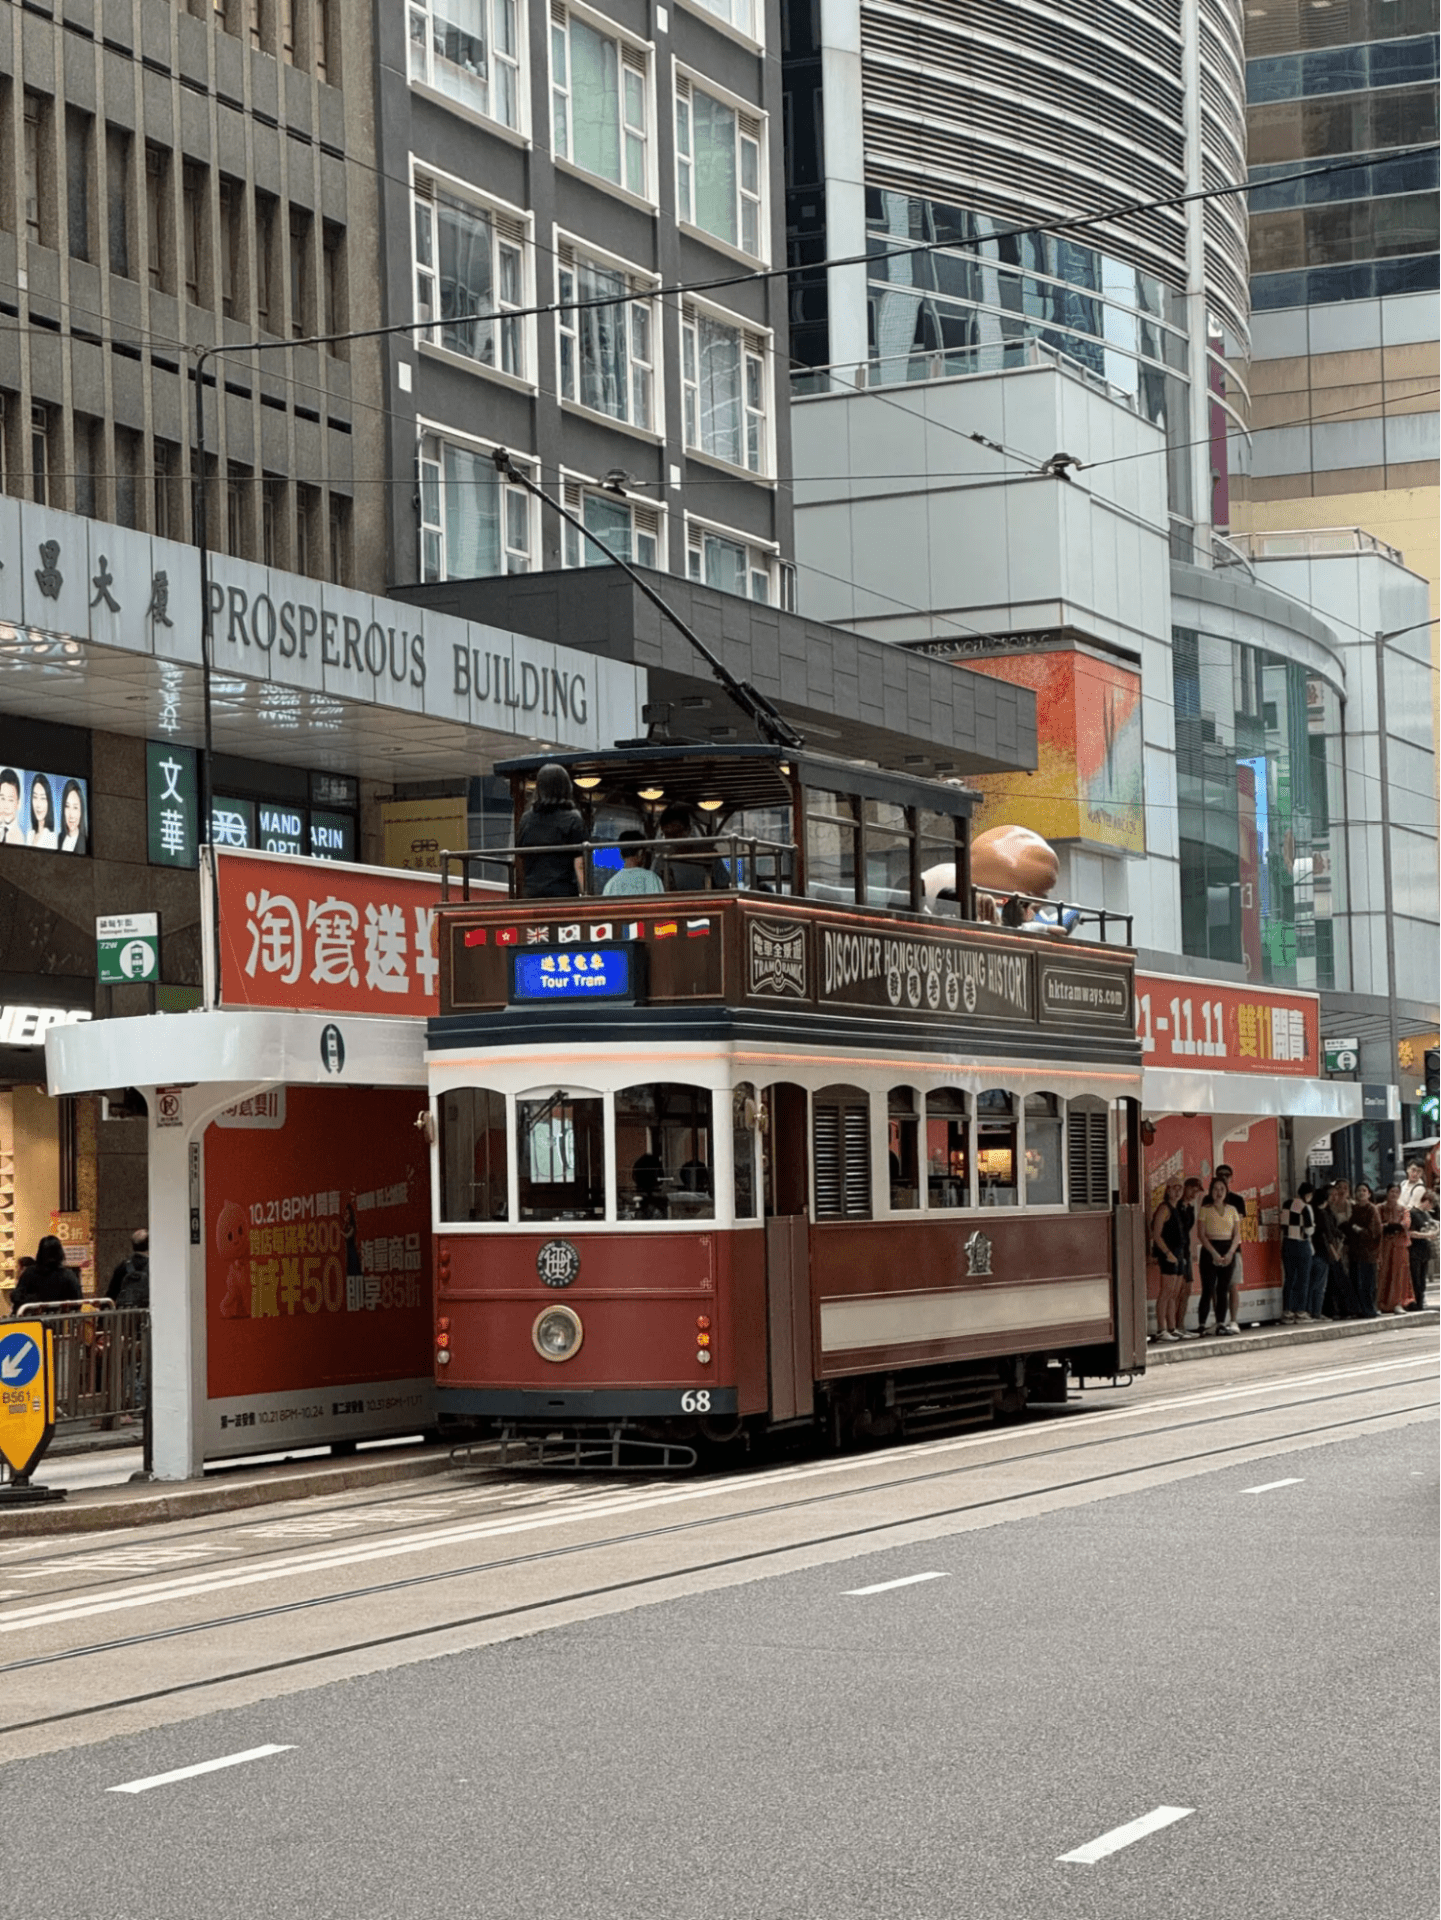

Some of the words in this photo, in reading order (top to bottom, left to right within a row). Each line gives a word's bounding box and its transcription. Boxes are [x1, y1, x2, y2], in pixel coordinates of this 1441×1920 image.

[0, 538, 175, 629] 昌大廈
[206, 581, 426, 688] PROSPEROUS
[453, 644, 588, 725] BUILDING
[158, 756, 185, 857] 文華
[540, 974, 570, 989] Tour
[572, 973, 607, 988] Tram
[825, 931, 882, 995] DISCOVER
[884, 939, 954, 975] HONGKONG'S
[953, 949, 987, 987] LIVING
[987, 953, 1028, 1013] HISTORY
[1048, 978, 1122, 1006] hktramways.com
[681, 1389, 711, 1413] 68
